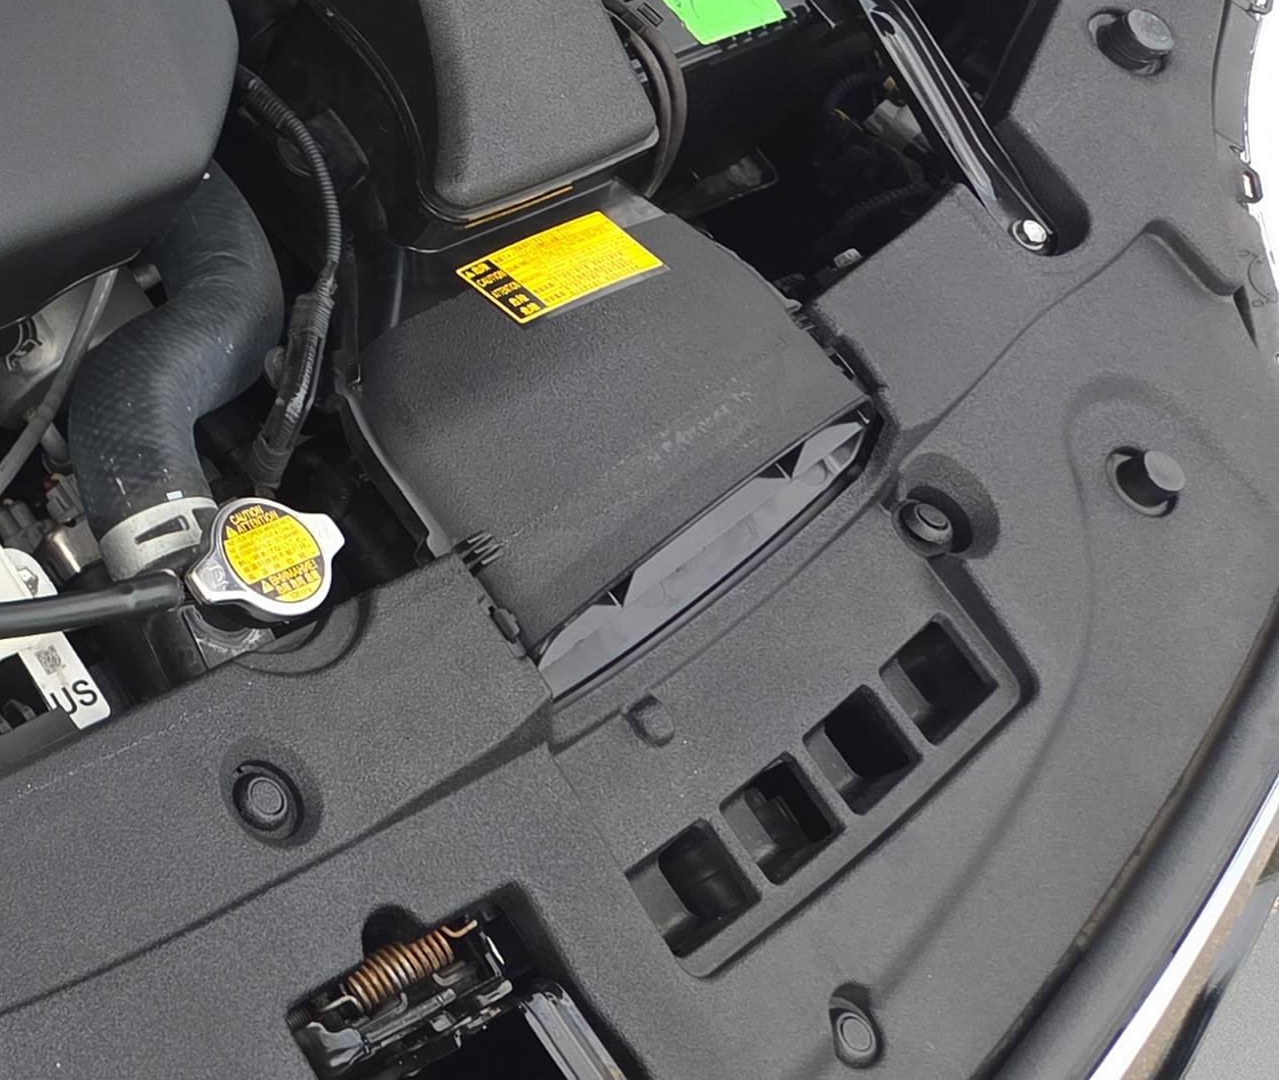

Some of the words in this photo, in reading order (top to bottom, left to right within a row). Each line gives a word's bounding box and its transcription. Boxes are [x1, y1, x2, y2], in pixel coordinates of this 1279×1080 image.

[230, 504, 264, 526] CAUTION
[236, 510, 279, 534] ATTENTION
[50, 680, 98, 715] US
